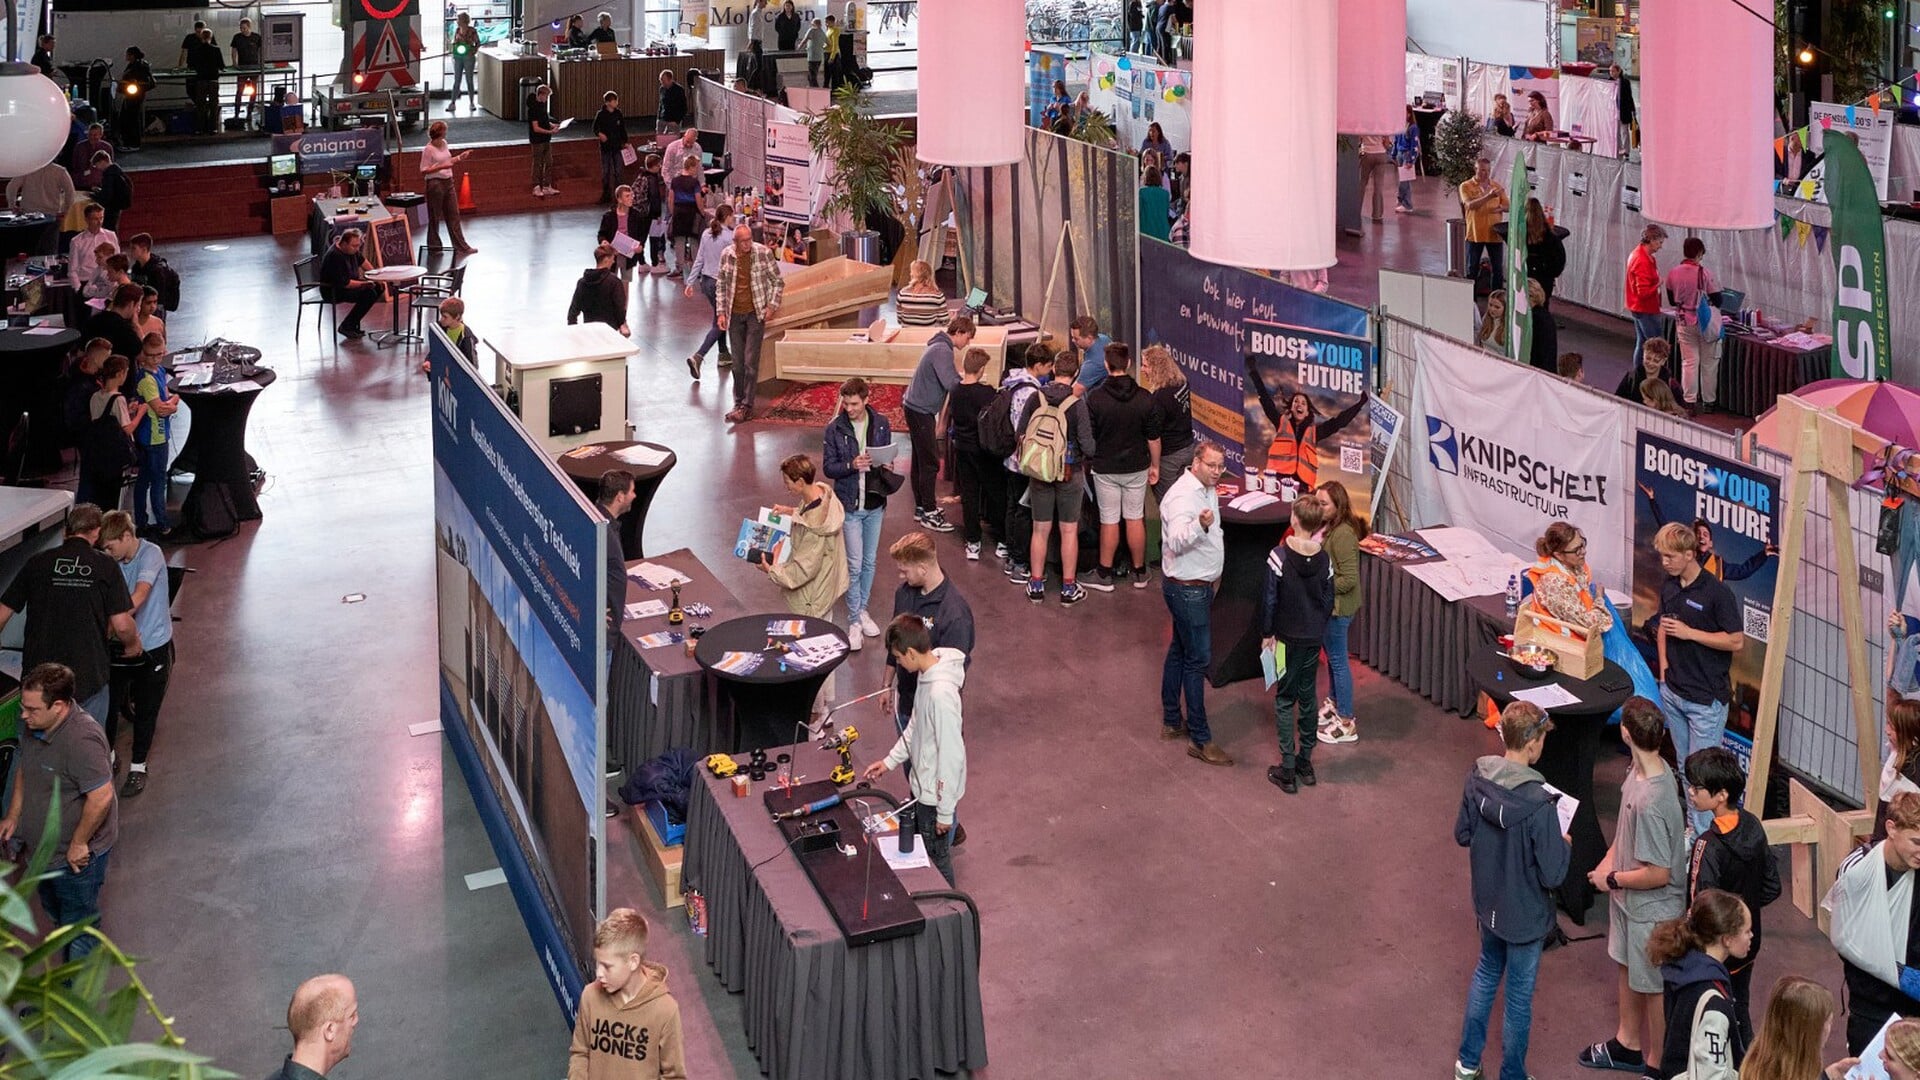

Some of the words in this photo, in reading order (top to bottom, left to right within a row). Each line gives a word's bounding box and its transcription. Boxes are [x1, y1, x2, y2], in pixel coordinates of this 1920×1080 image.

[303, 138, 366, 155] enigma
[1180, 304, 1191, 318] en
[1203, 276, 1220, 301] Ook
[1226, 287, 1245, 310] hier
[1873, 252, 1887, 368] PERFECTION
[1251, 331, 1308, 361] BOOST
[1314, 341, 1363, 370] YOUR
[1297, 362, 1363, 395] FUTURE
[1464, 464, 1569, 518] INFRASTRUCTUUR
[1644, 443, 1708, 490] BOOST
[1714, 467, 1770, 513] YOUR
[1695, 490, 1771, 543] FUTURE
[549, 518, 580, 582] Techniek
[590, 1035, 647, 1061] JONES
[591, 1018, 649, 1044] JACK&
